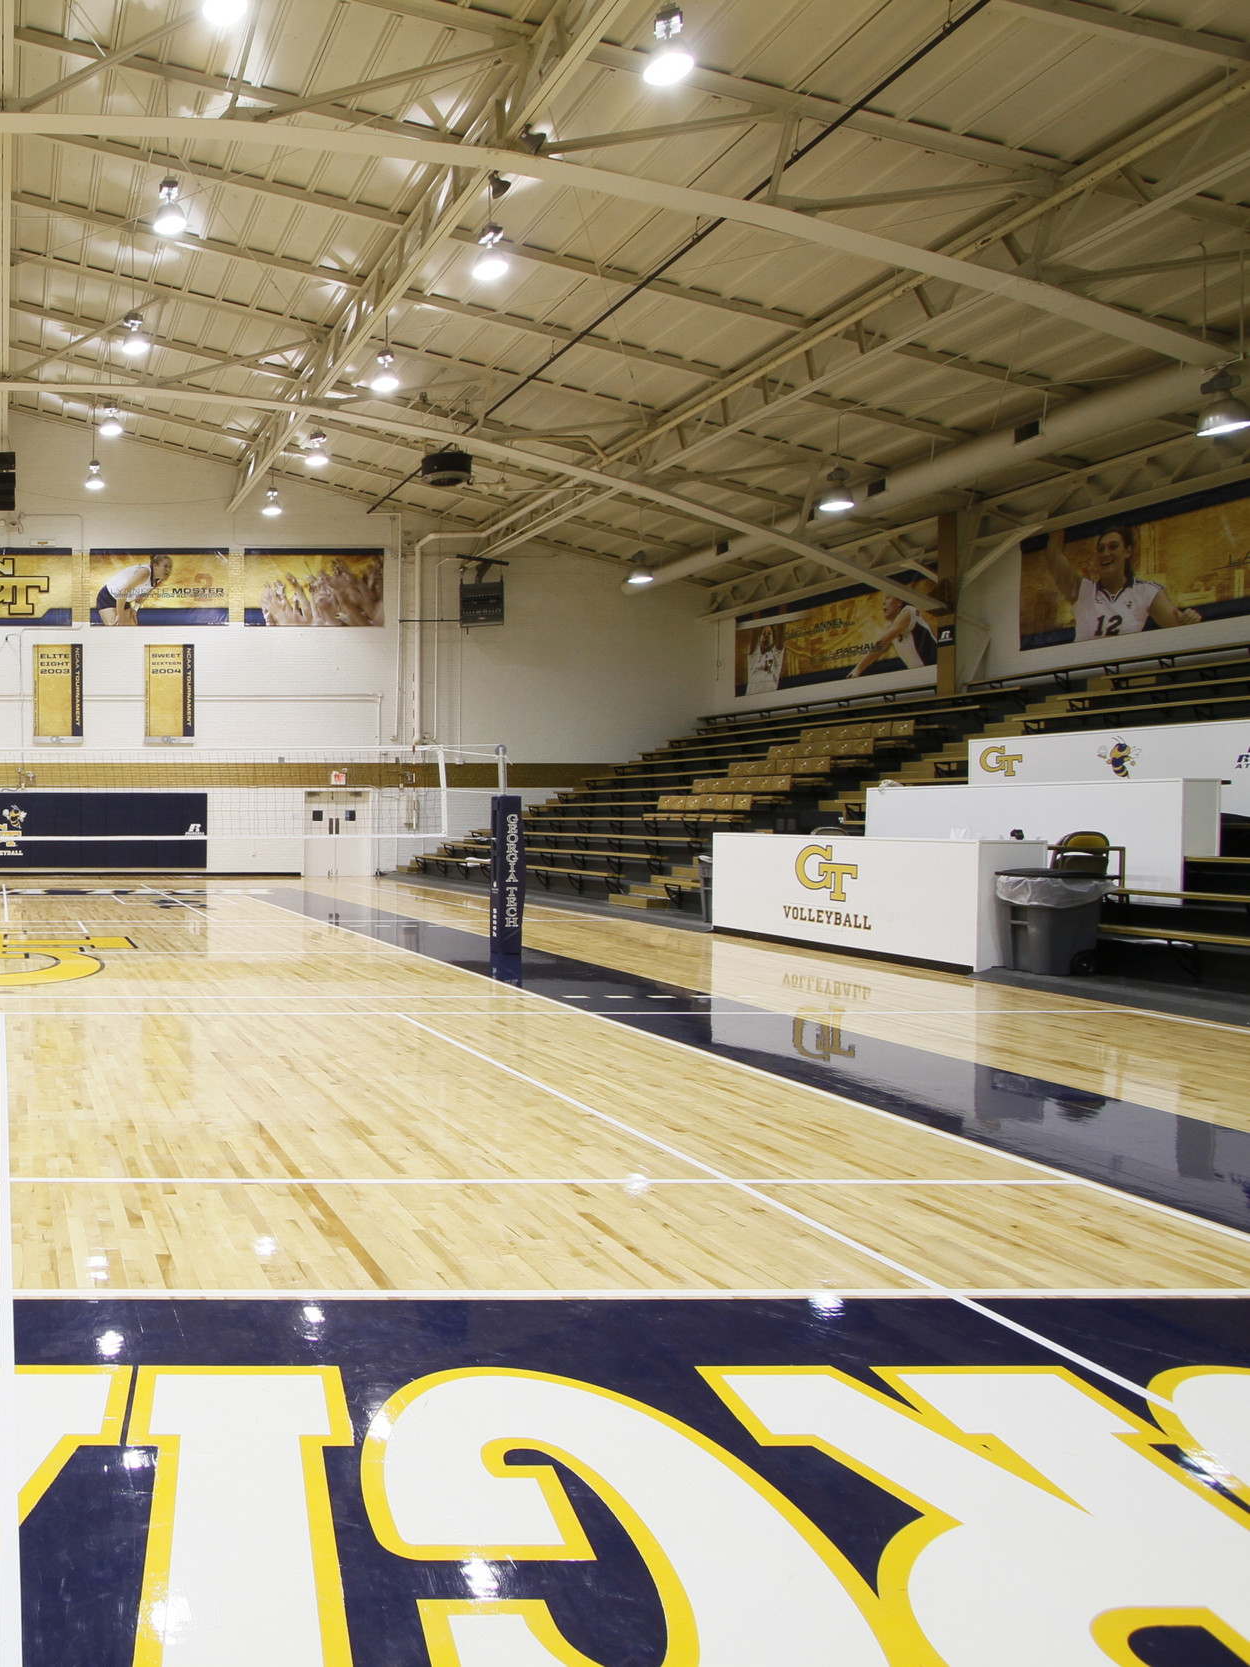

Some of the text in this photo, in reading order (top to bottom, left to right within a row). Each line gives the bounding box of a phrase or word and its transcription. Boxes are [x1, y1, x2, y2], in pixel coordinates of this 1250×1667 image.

[1094, 614, 1123, 637] 12
[979, 745, 1023, 777] GT
[505, 813, 519, 883] GEORGIA
[795, 844, 858, 902] GT
[505, 886, 519, 928] TECH
[782, 905, 872, 931] VOLLEYBALL
